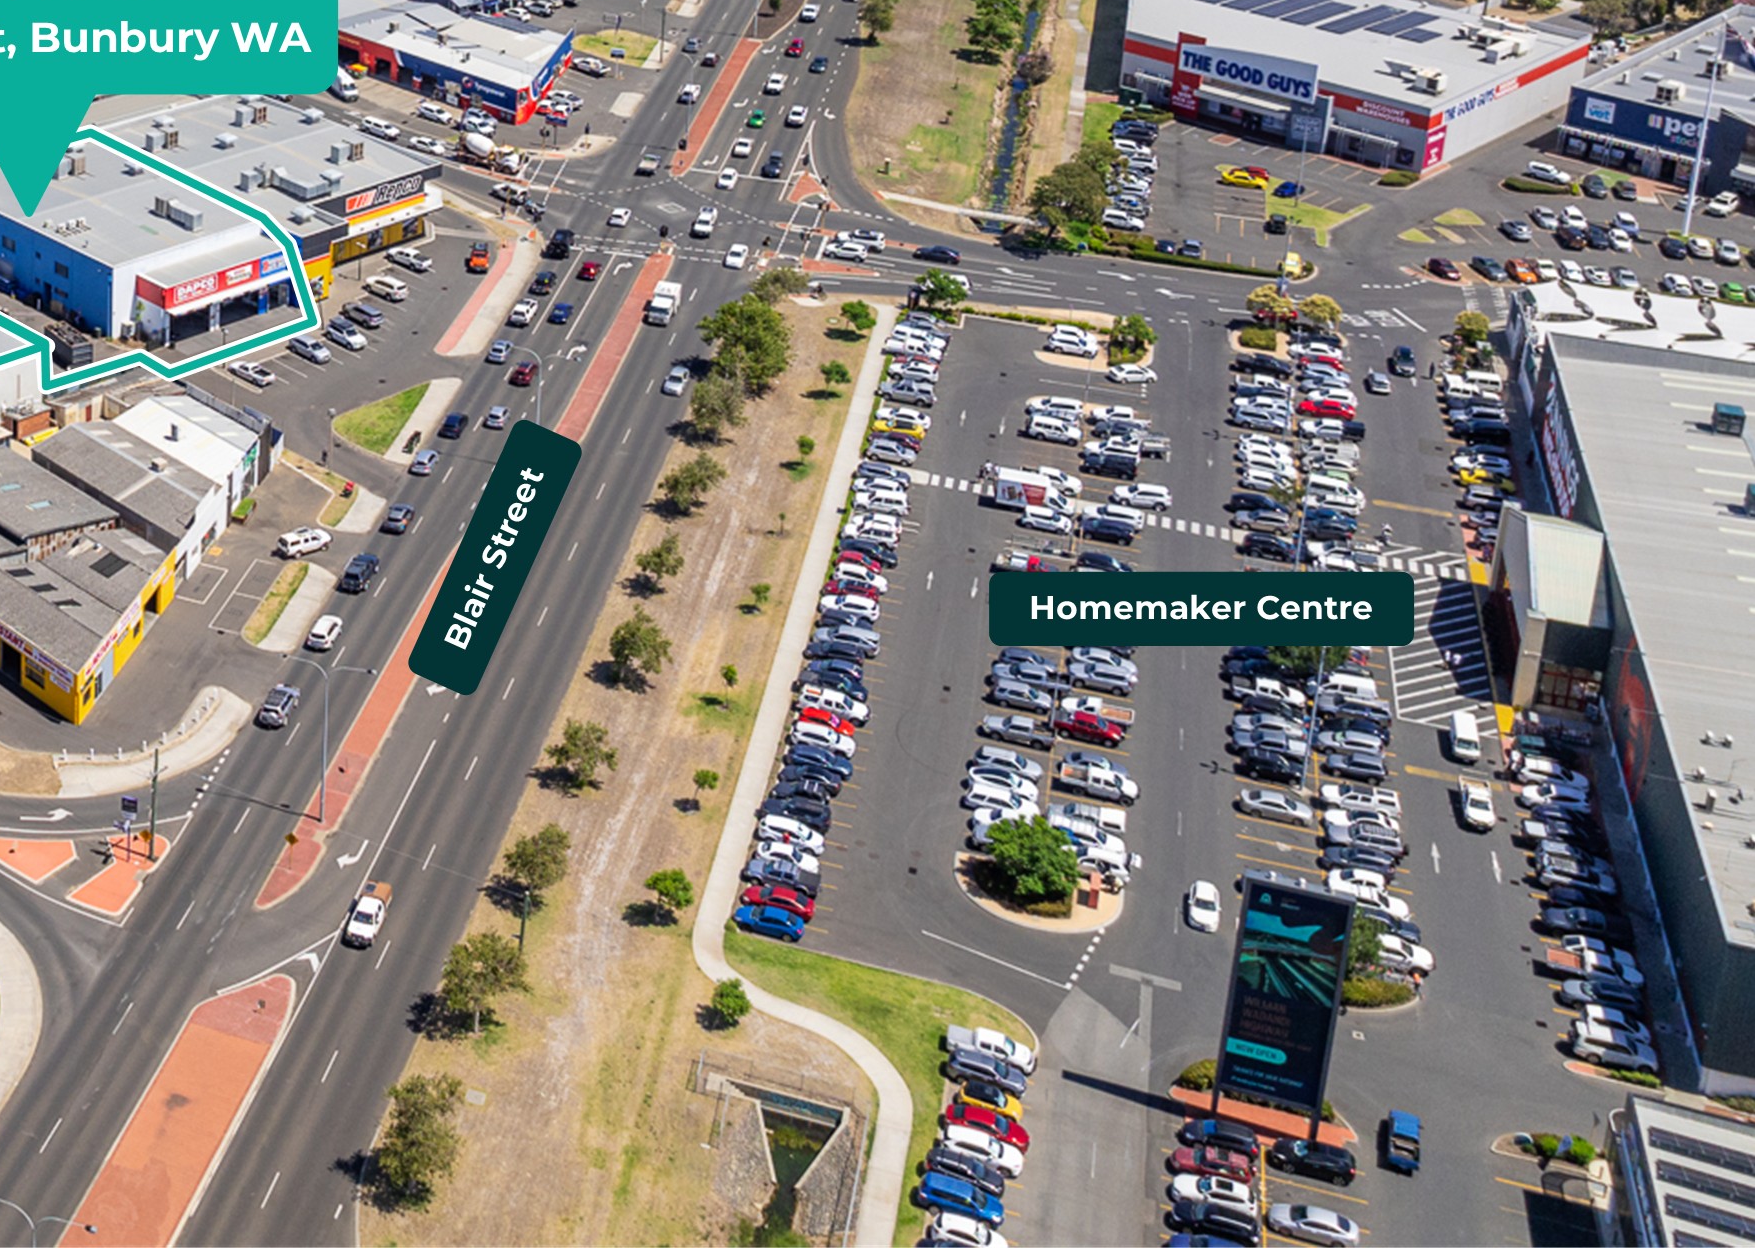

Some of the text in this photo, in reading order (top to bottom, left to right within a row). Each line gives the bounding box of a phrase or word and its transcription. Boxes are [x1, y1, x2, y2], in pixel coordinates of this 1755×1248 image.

[1182, 50, 1312, 99] THE GOOD GUYS
[1588, 107, 1612, 121] vet
[374, 175, 423, 204] Repco
